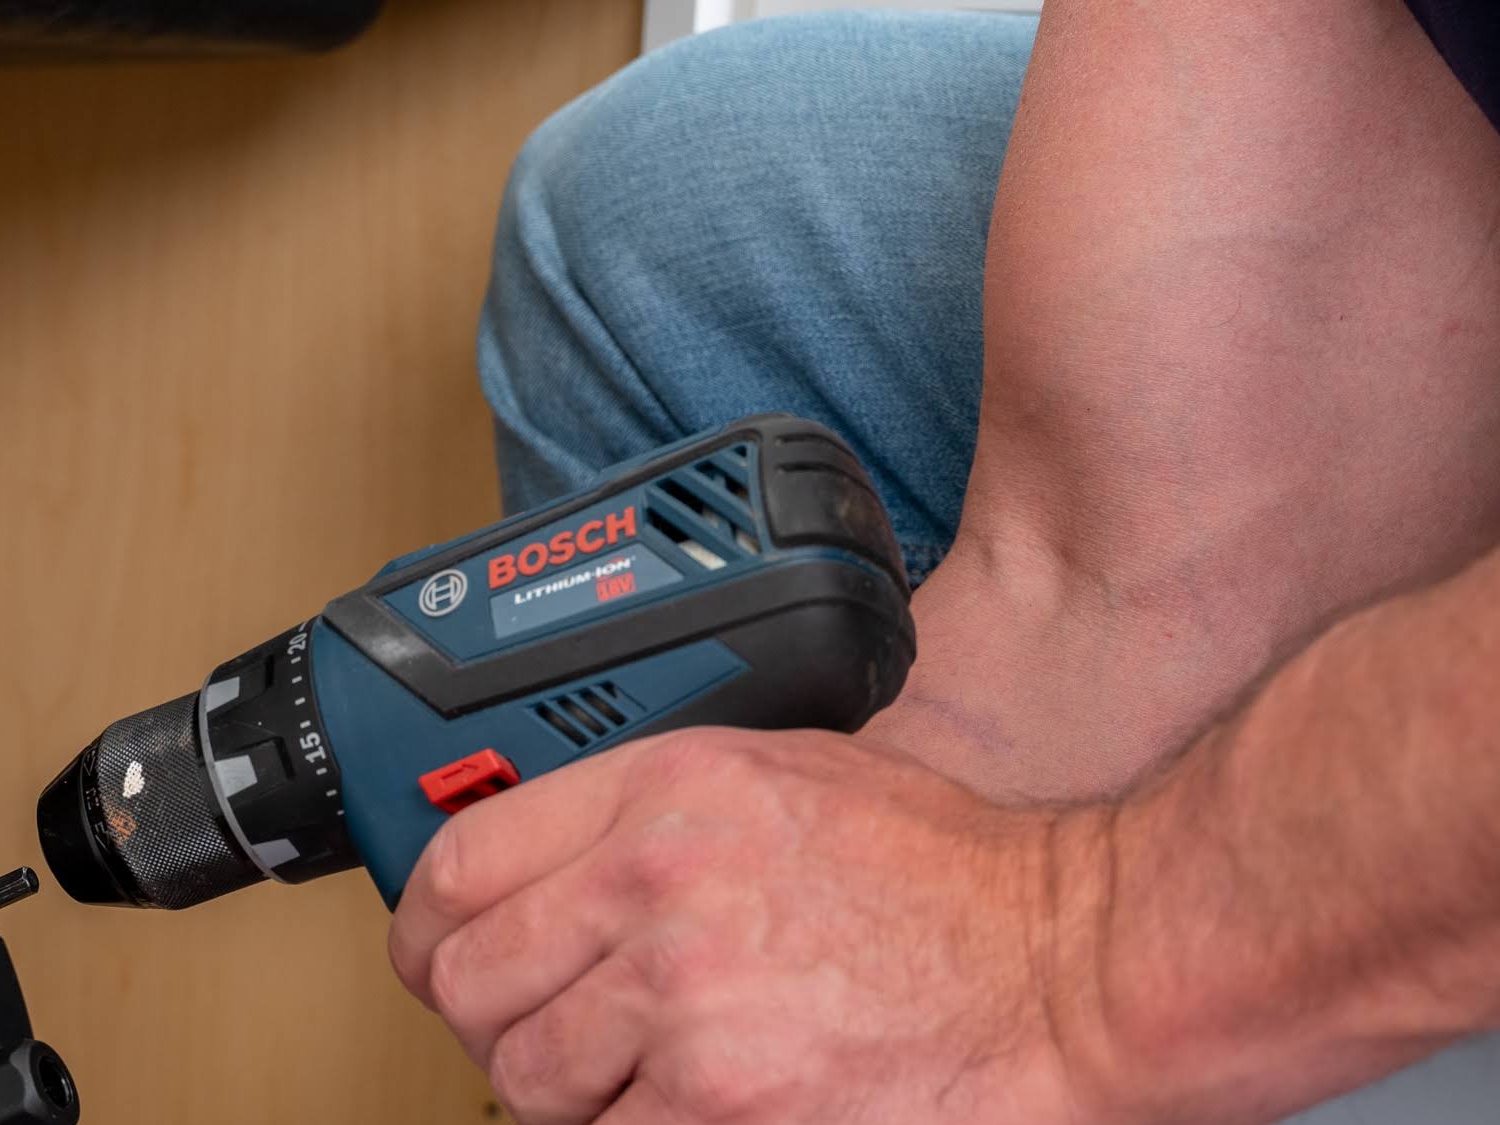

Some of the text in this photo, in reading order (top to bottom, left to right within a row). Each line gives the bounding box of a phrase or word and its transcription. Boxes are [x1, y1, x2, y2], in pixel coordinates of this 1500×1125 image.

[488, 506, 636, 589] BOSCH
[514, 557, 631, 604] LITHIUM-ION
[287, 633, 307, 655] 20
[299, 732, 326, 763] 15
